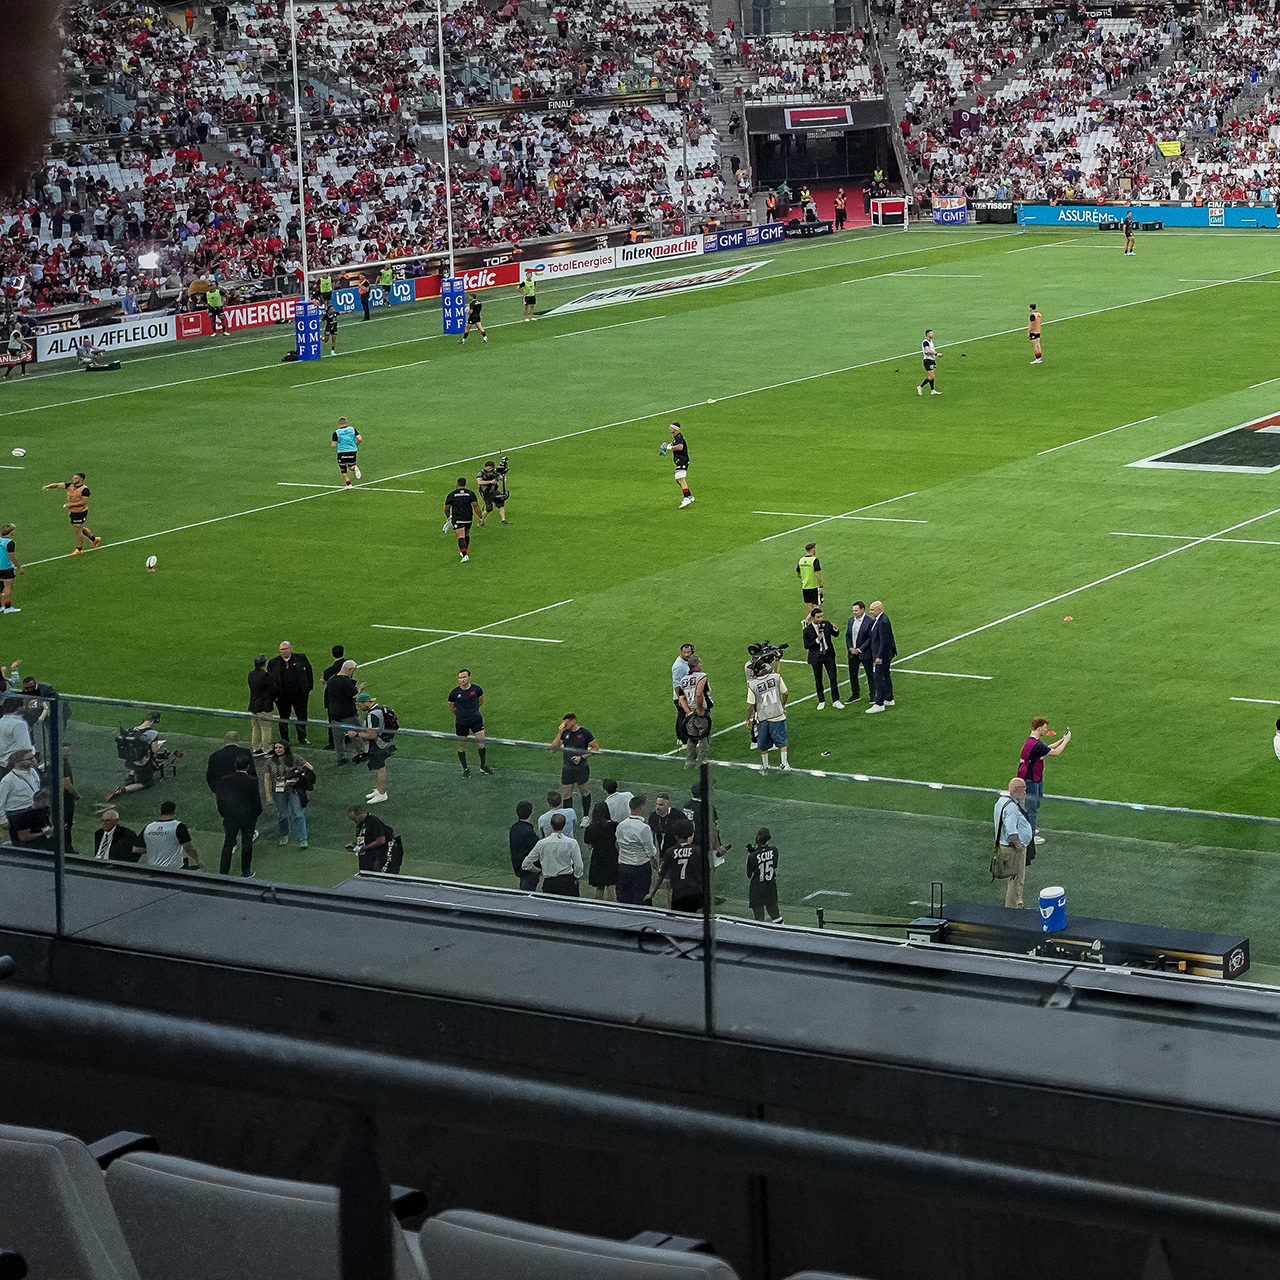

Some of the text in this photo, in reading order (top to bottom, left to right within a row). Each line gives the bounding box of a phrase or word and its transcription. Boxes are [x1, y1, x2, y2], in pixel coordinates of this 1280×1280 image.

[986, 202, 1012, 210] TISSOT
[943, 212, 965, 221] GMF
[720, 233, 743, 247] GMF
[761, 227, 783, 241] GMF
[622, 238, 698, 261] Intermarché
[548, 255, 612, 274] TotalEnergies
[463, 271, 496, 289] tclic
[444, 296, 453, 329] GMF
[455, 295, 464, 329] GMF
[47, 322, 168, 355] ALAIN AFFLELOU
[297, 321, 306, 355] GMF
[309, 320, 319, 355] GMF
[673, 847, 693, 859] SCUF
[757, 850, 774, 863] SCUF
[678, 859, 688, 879] 7
[758, 860, 774, 882] 15
